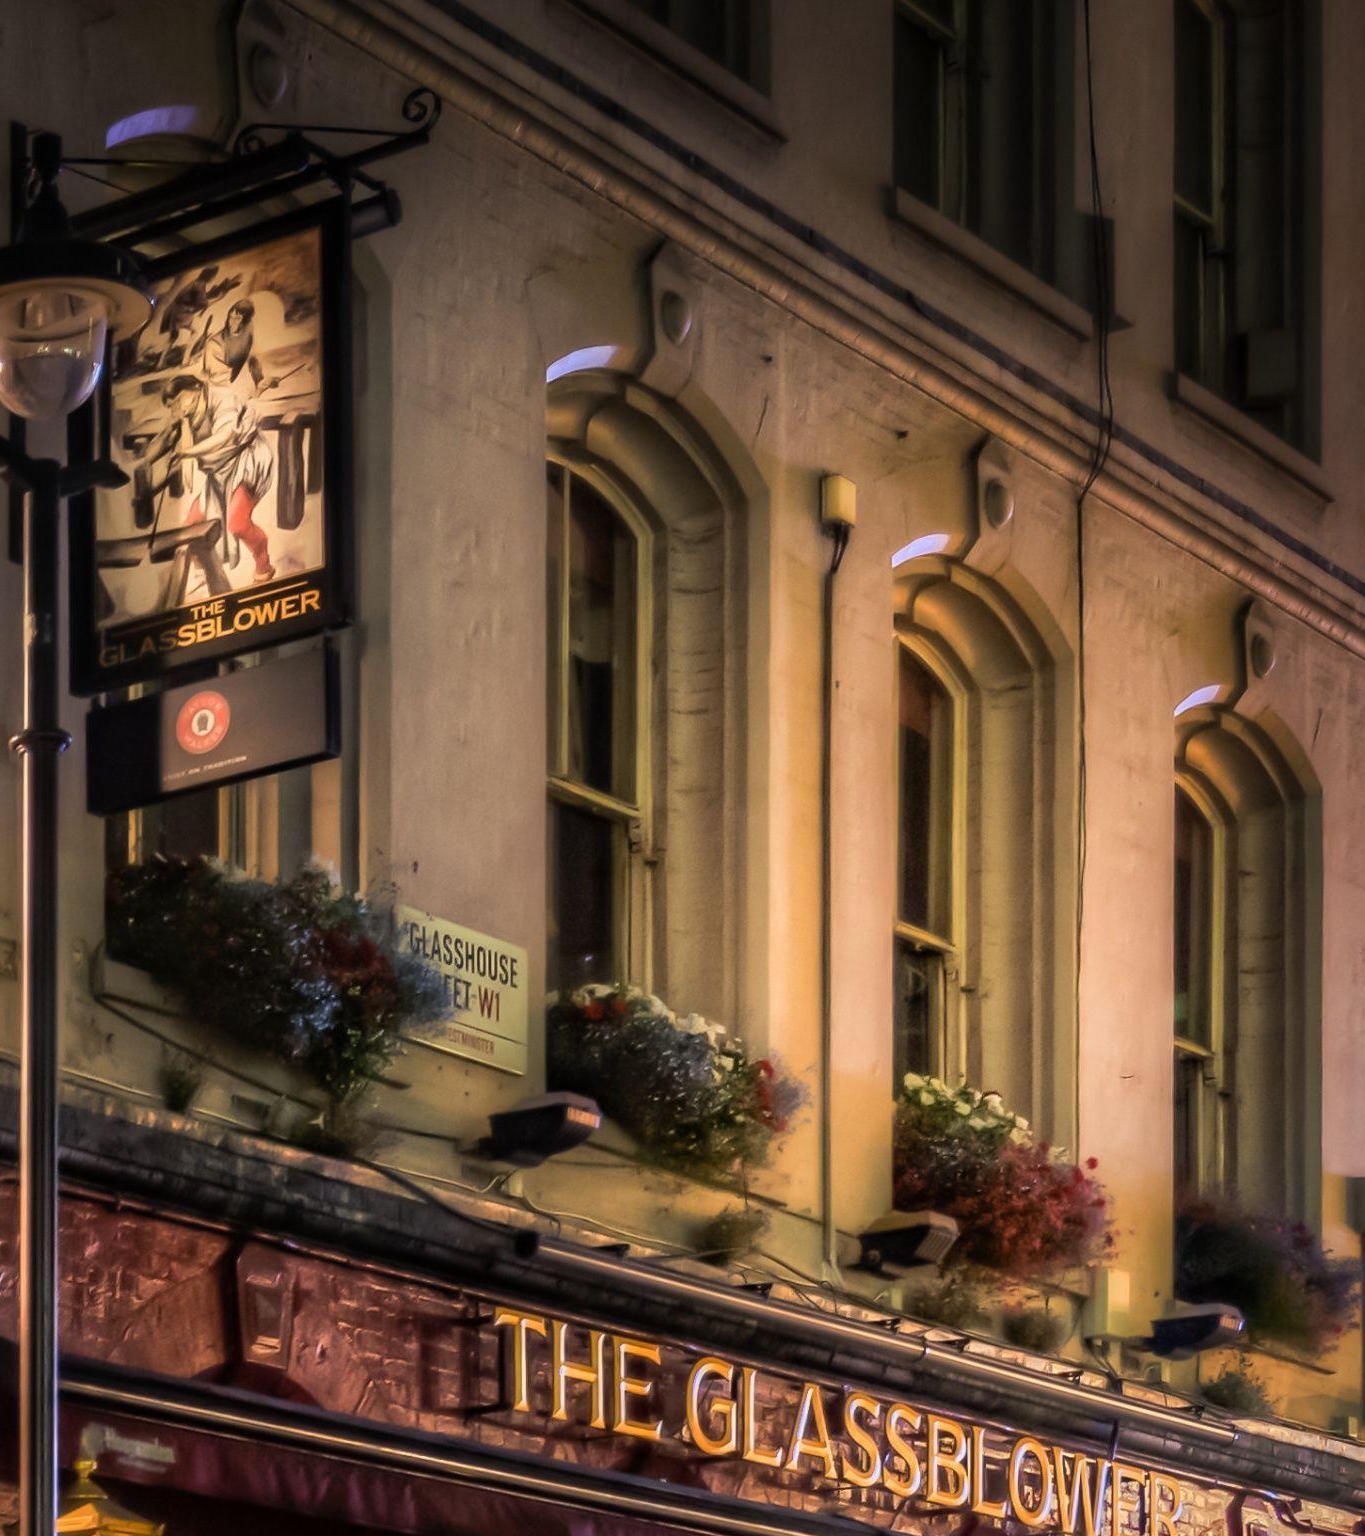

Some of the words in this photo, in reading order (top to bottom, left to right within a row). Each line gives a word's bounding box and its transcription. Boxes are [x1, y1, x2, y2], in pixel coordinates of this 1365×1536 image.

[98, 589, 321, 668] GLASSBLOWER
[191, 599, 226, 621] THE
[409, 921, 518, 988] GLASSHOUSE
[478, 985, 500, 1023] W1
[448, 1026, 495, 1055] ESTMINSTER
[494, 1306, 663, 1441] THE
